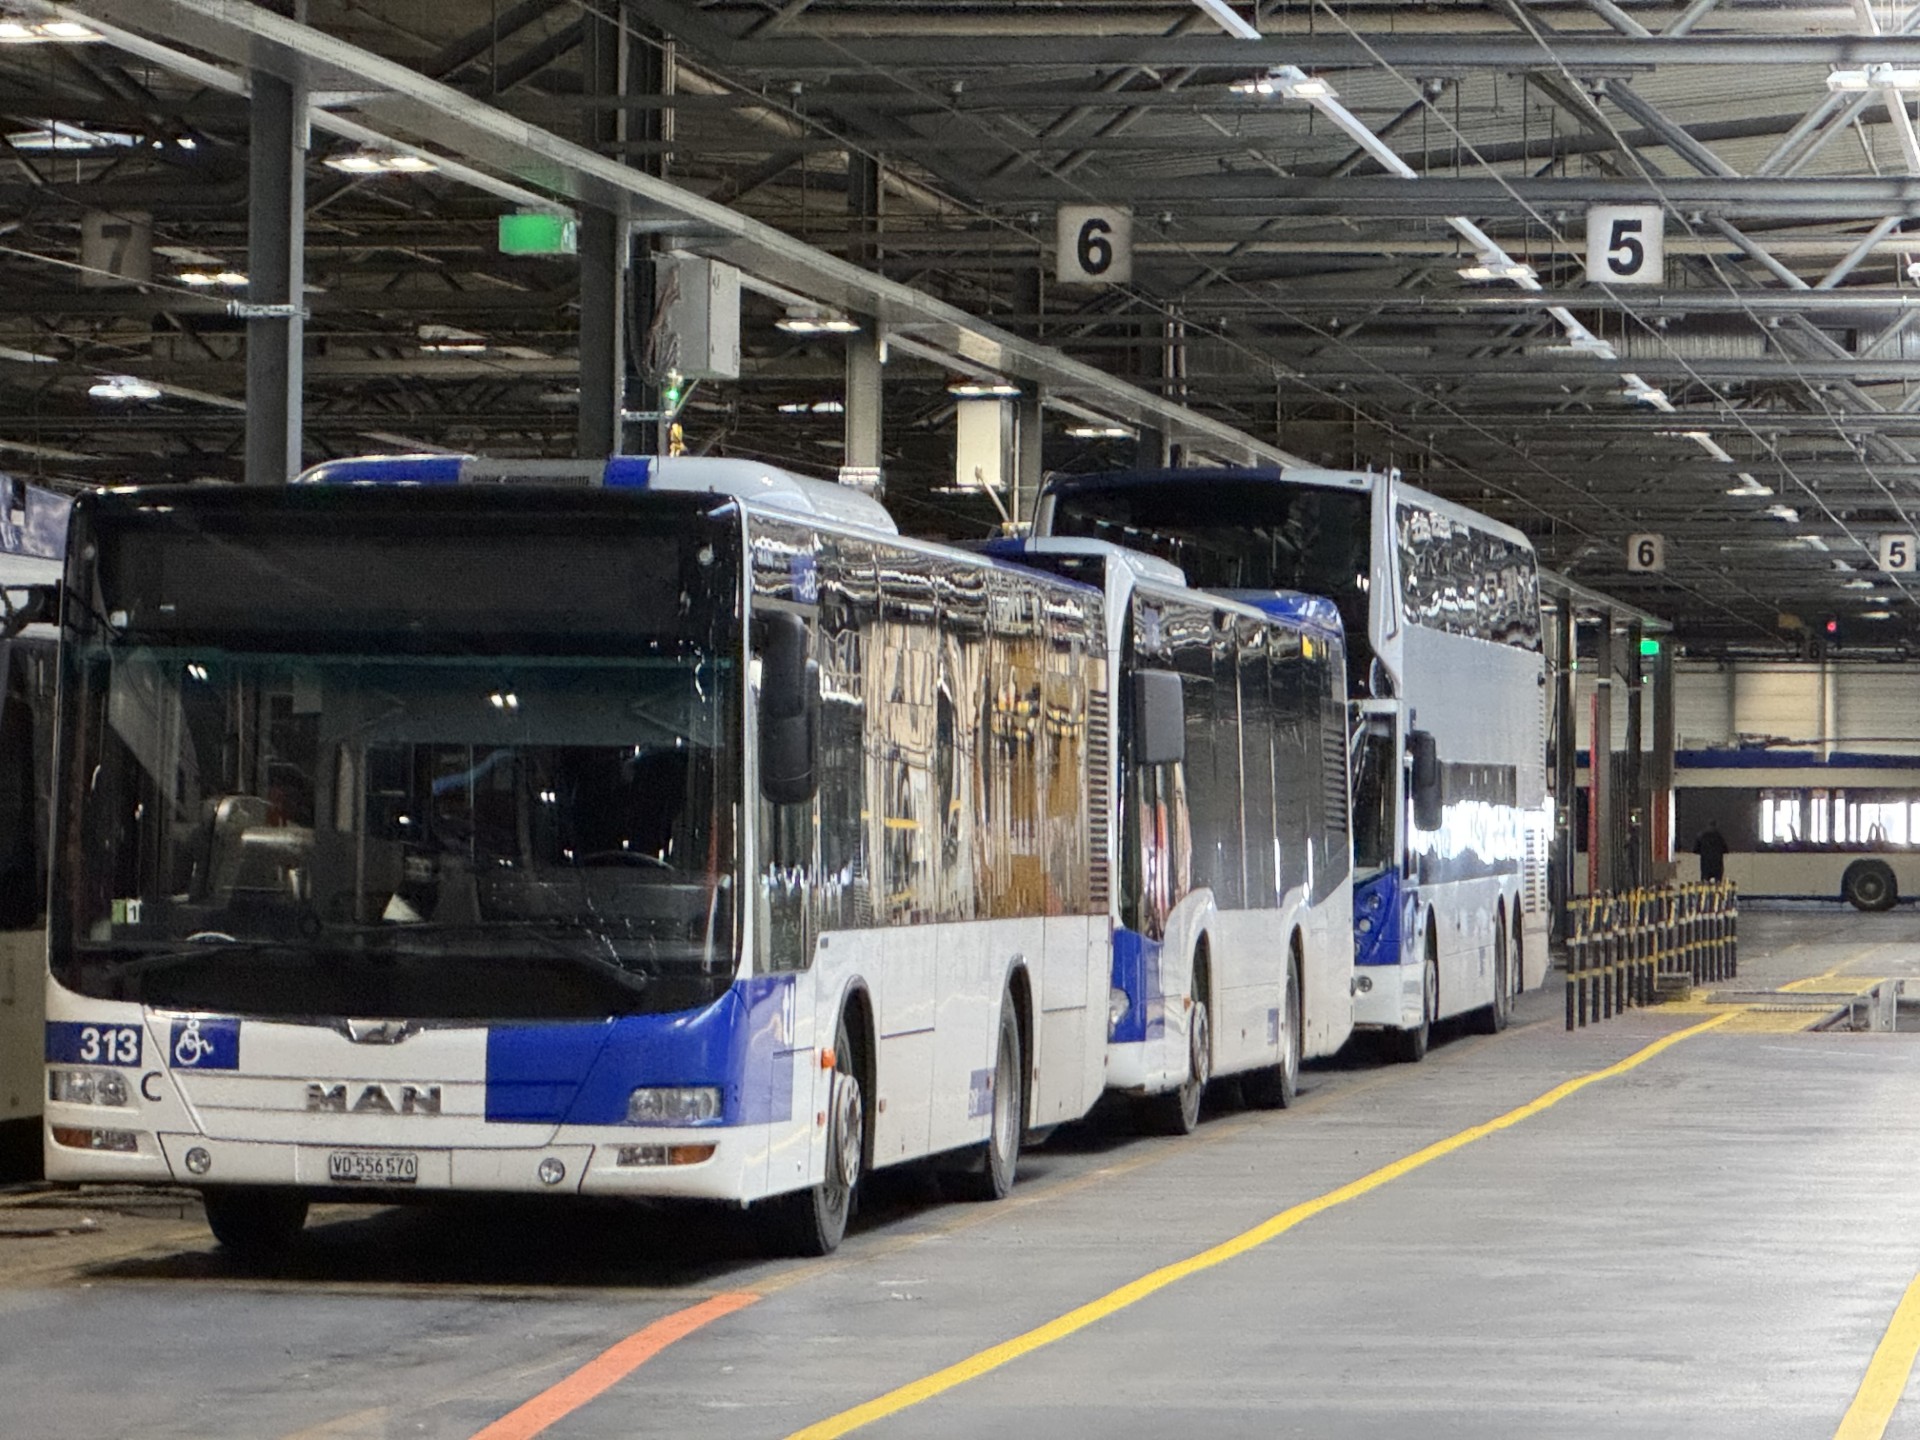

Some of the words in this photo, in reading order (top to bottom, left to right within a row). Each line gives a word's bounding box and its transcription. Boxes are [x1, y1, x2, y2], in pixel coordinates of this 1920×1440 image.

[101, 224, 132, 279] 7
[1077, 218, 1112, 275] 6
[1607, 219, 1644, 275] 5
[1637, 540, 1655, 567] 6
[1889, 541, 1906, 568] 5
[80, 1027, 138, 1063] 313
[141, 1071, 162, 1102] C
[306, 1081, 443, 1115] MAN
